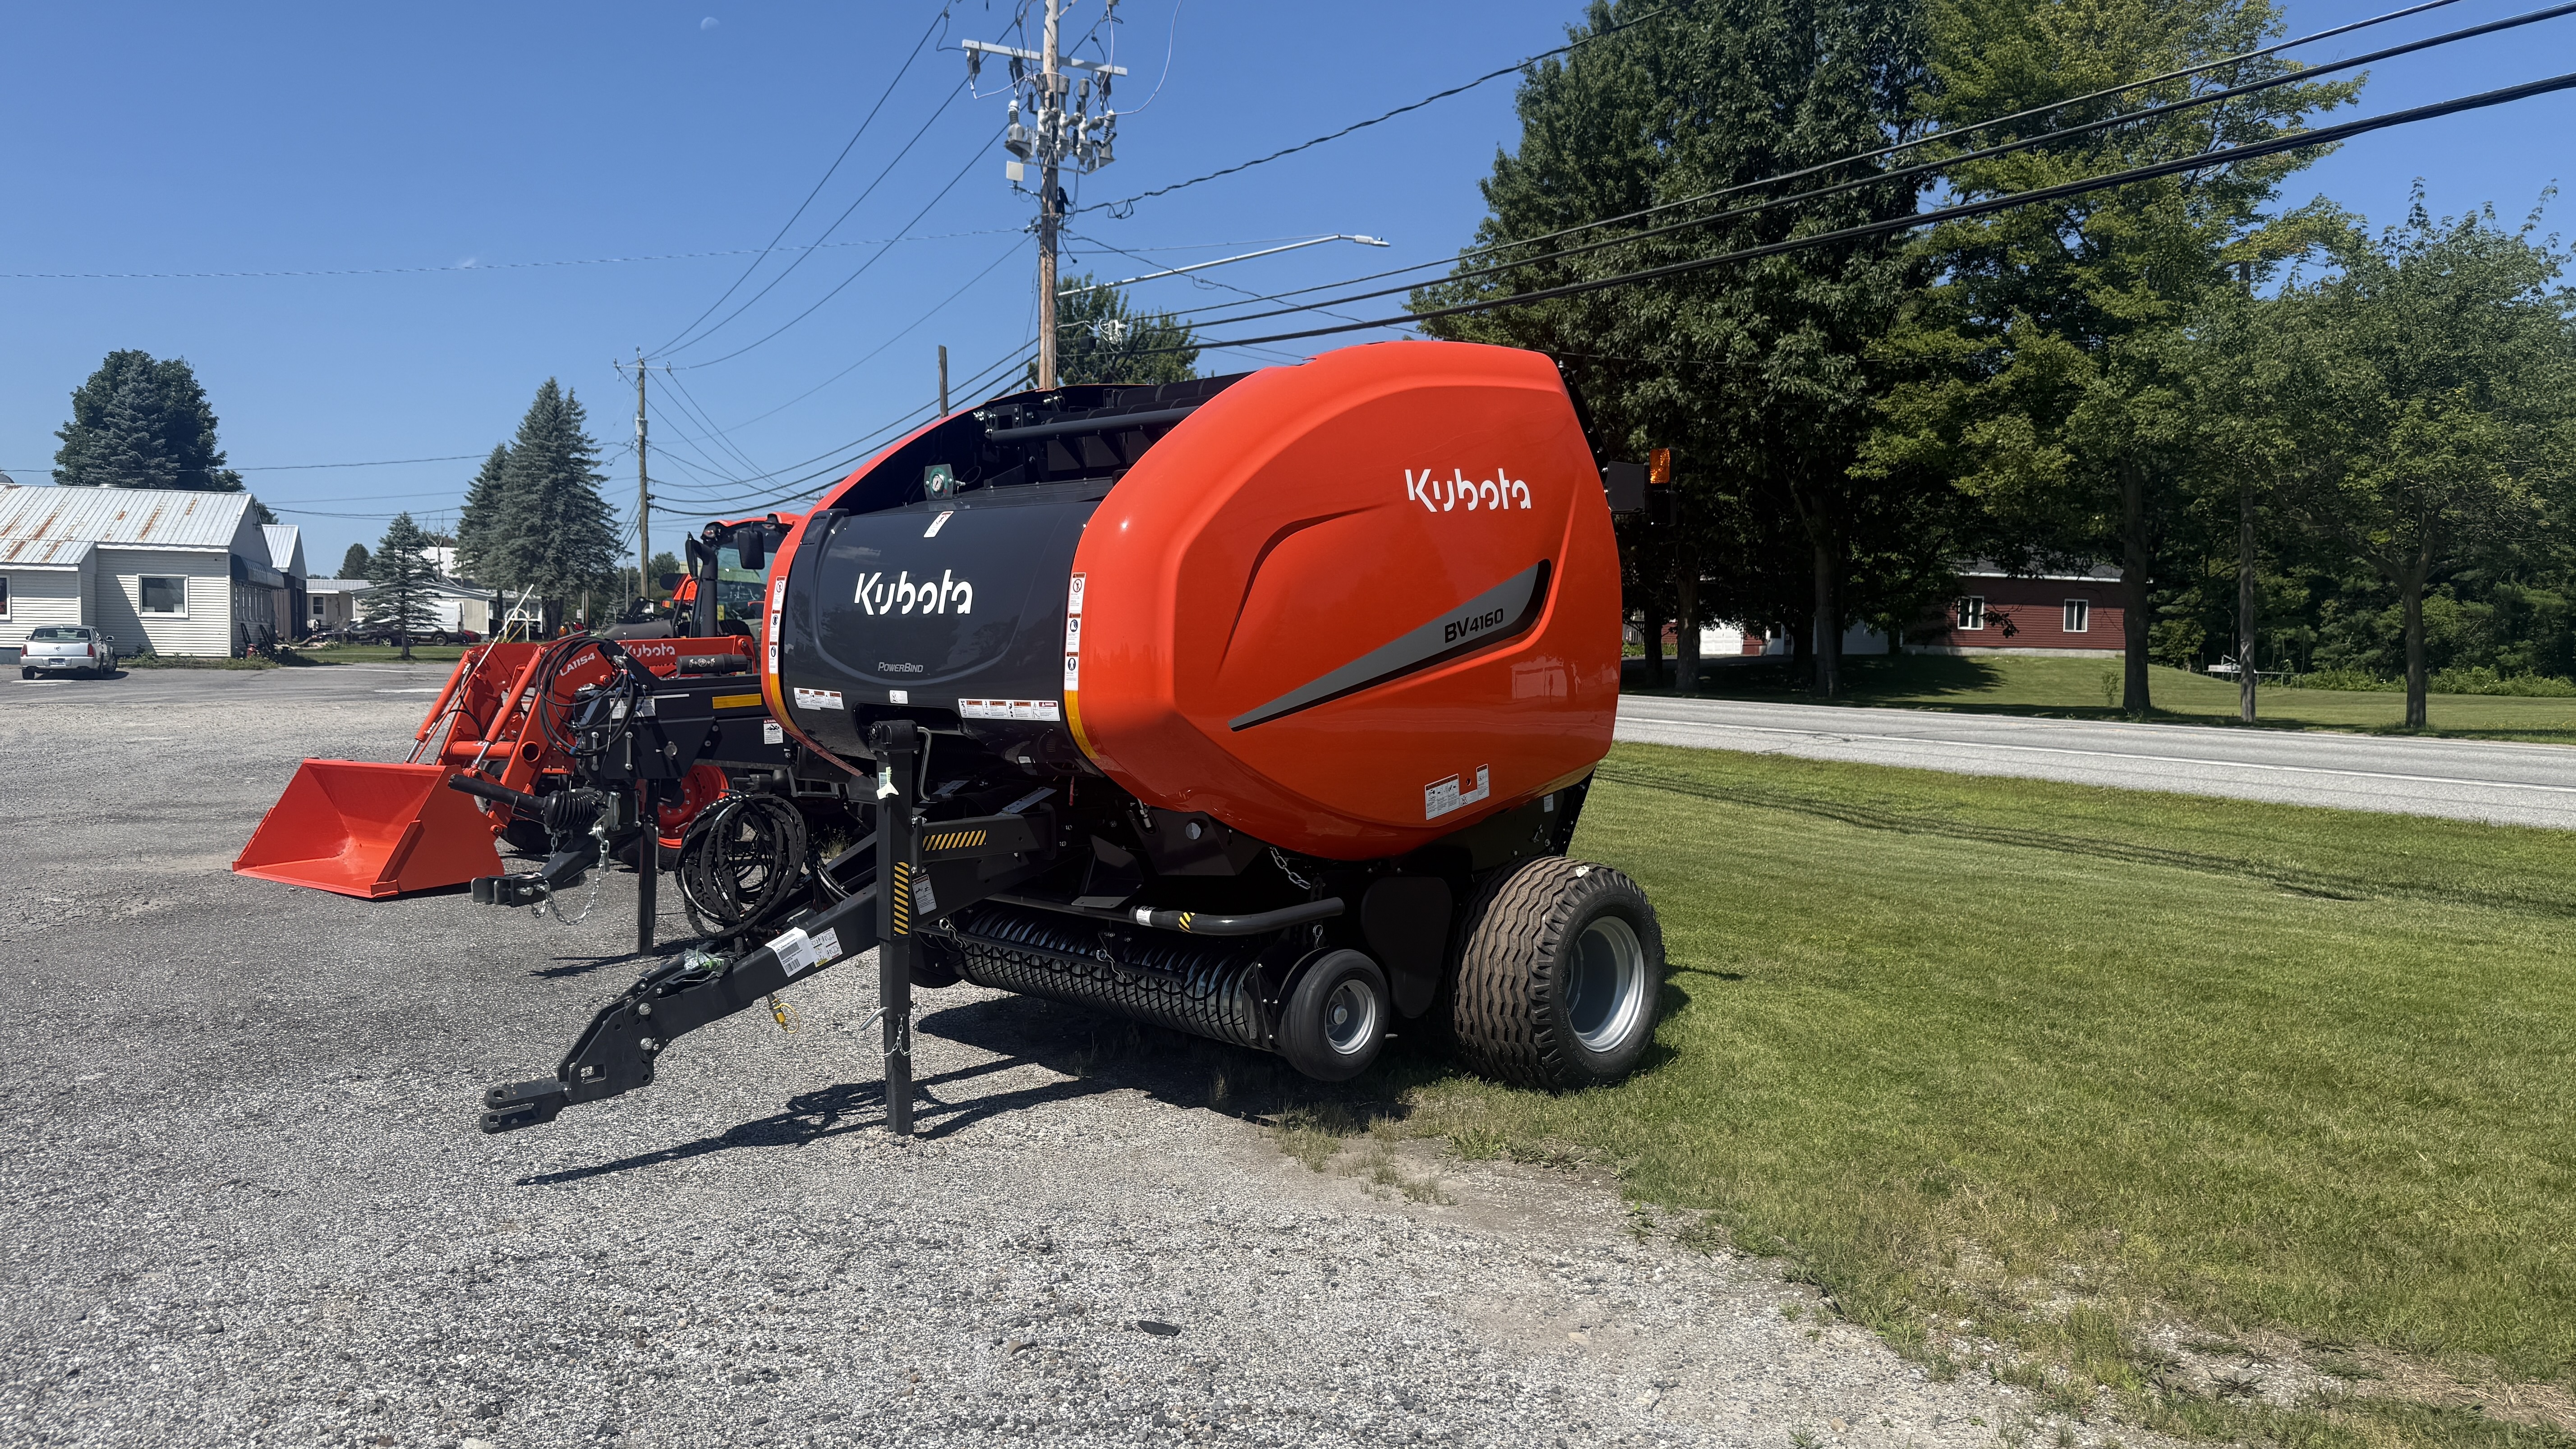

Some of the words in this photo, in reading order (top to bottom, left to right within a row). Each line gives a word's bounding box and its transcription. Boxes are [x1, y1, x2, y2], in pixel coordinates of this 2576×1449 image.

[1404, 468, 1532, 512] Kubota
[854, 569, 973, 615] Kubota
[1445, 608, 1504, 644] BV4160
[560, 653, 595, 676] LA1154
